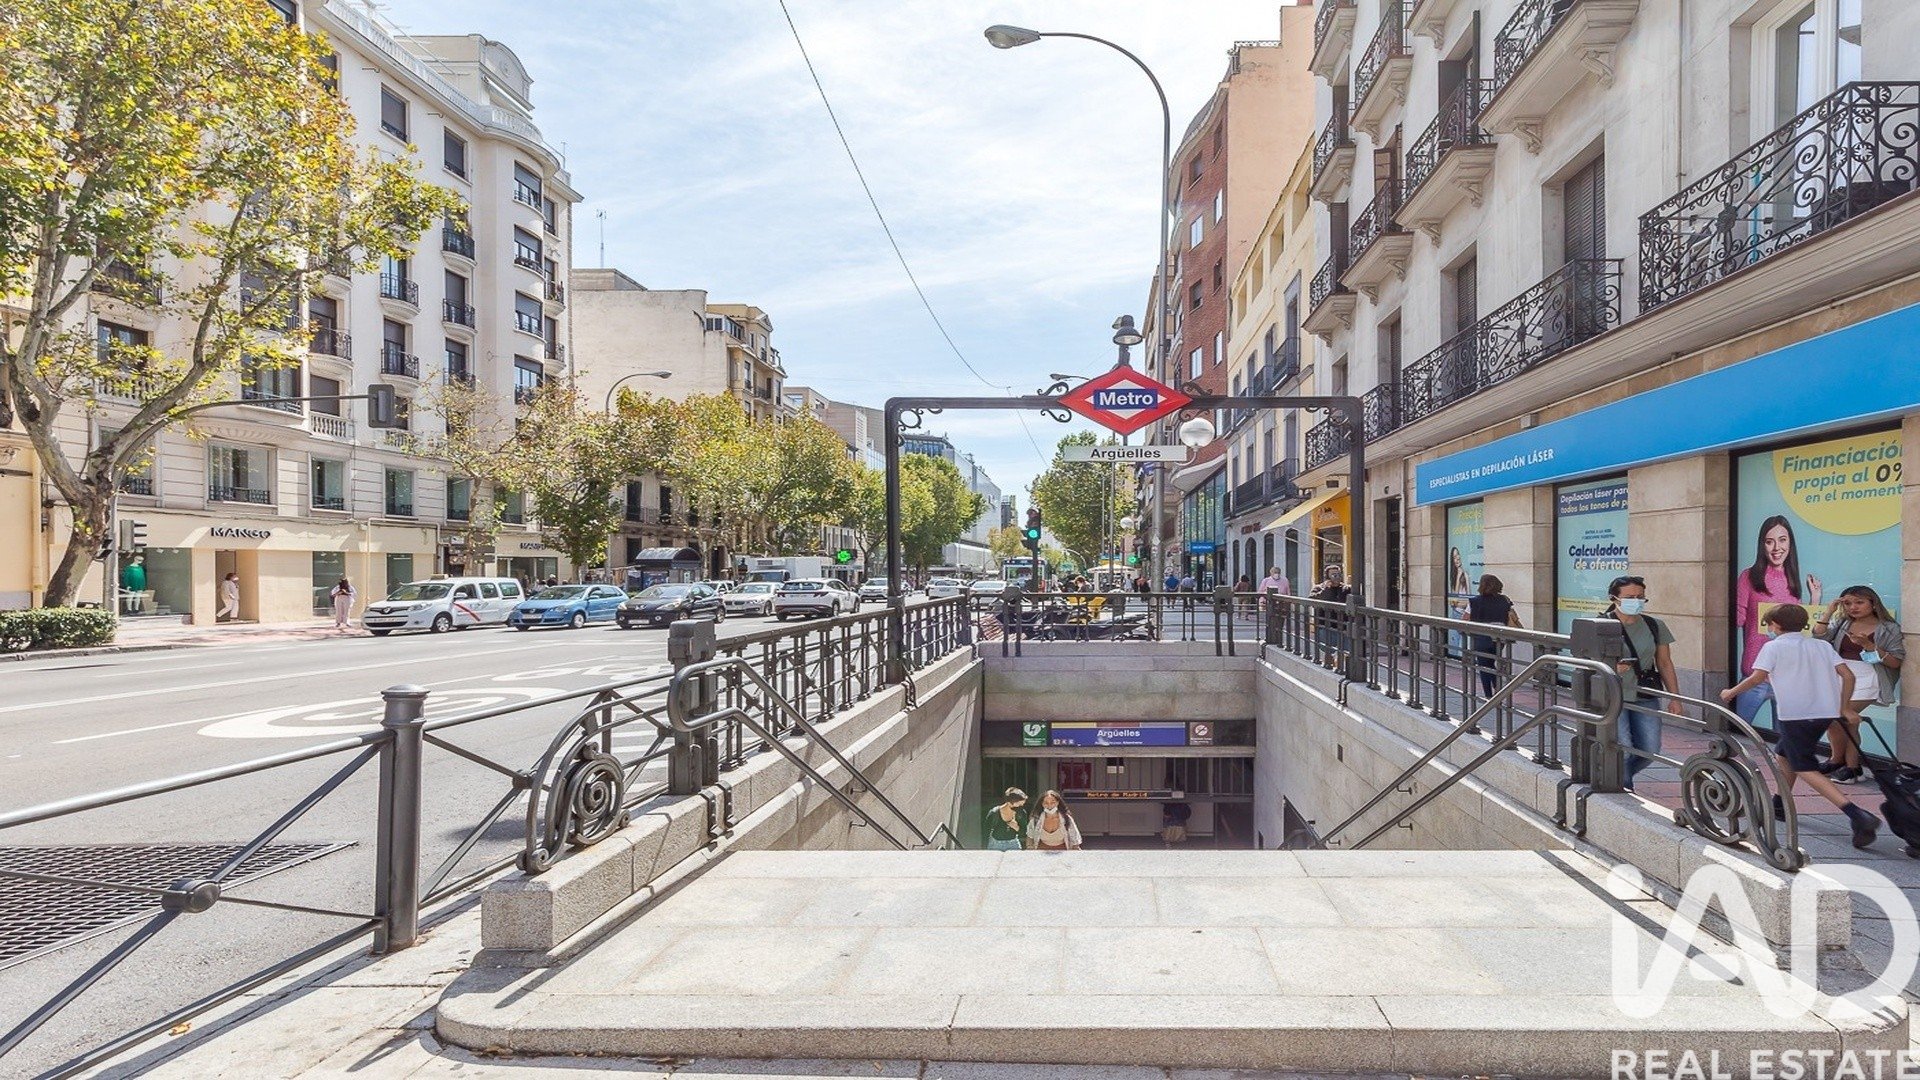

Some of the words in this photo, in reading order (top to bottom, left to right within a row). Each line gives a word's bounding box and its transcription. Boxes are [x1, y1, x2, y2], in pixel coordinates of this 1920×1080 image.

[1100, 392, 1153, 406] Metro
[1090, 448, 1161, 461] Argüelles
[1783, 440, 1902, 473] Financiació
[1430, 470, 1470, 489] ESPECIALISTAS
[1471, 468, 1480, 479] EN
[1482, 455, 1525, 476] DEPILACIÓN
[1528, 448, 1554, 465] LÁSER
[1793, 471, 1846, 494] propia
[1852, 467, 1869, 483] al
[1560, 492, 1593, 504] Depilación
[1594, 489, 1612, 499] láser
[1805, 493, 1820, 503] en
[1825, 490, 1837, 501] el
[1560, 506, 1578, 514] todos
[1580, 503, 1589, 512] los
[1590, 502, 1609, 511] tonos
[1610, 499, 1620, 508] de
[211, 528, 271, 539] MANGO
[520, 542, 547, 551] MANG
[1574, 559, 1587, 570] de
[1589, 558, 1628, 571] ofertas
[1097, 729, 1141, 739] Argüelles
